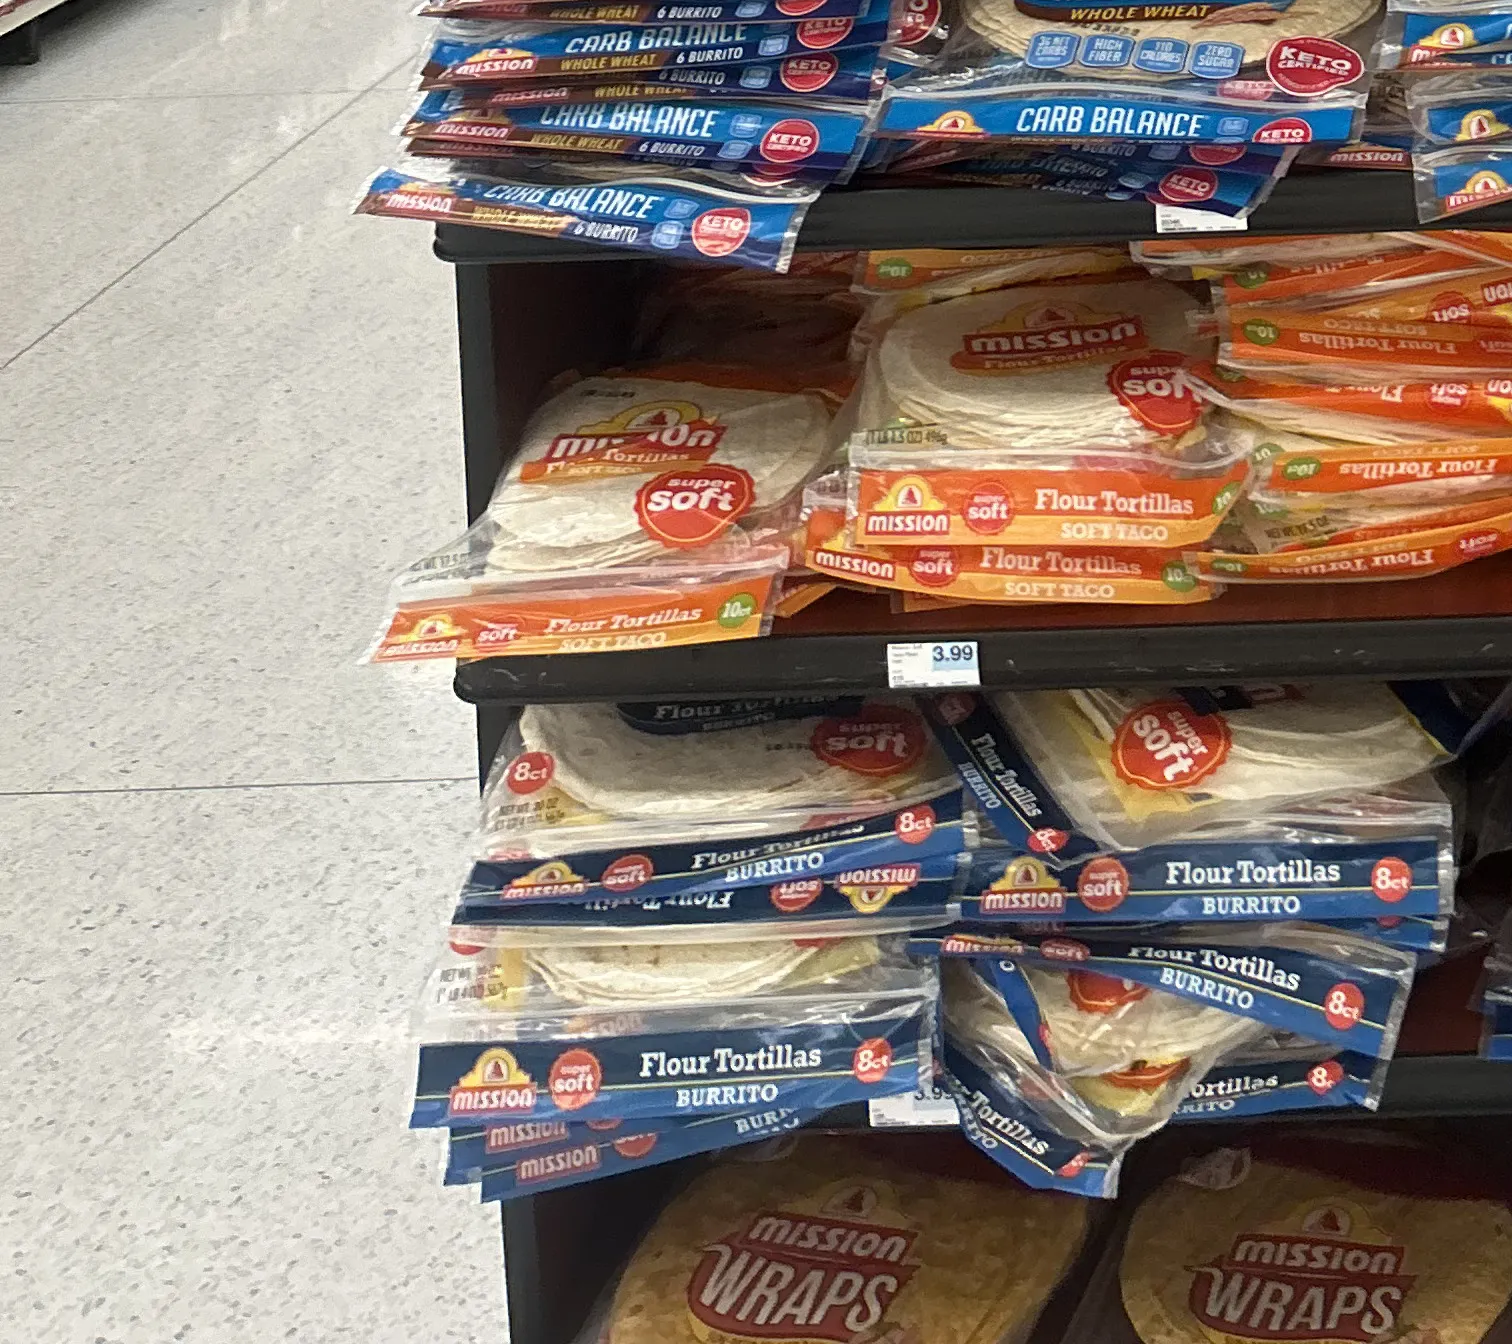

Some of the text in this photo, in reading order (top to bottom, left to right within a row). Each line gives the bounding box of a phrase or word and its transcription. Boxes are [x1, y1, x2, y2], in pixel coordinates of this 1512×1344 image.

[1069, 3, 1211, 21] WHOLE WHEAT
[1279, 45, 1352, 72] KETO
[1016, 107, 1204, 137] CARB BALANCE
[639, 140, 705, 156] 6 BURRITO
[768, 132, 813, 147] KETO
[667, 478, 736, 490] super
[646, 488, 735, 512] soft
[1035, 488, 1194, 515] Flour Tortillas
[1061, 523, 1168, 541] SOFT TACO
[979, 548, 1142, 575] Flour Tortillas
[1005, 582, 1115, 598] SOFT TACO
[933, 645, 974, 662] 3.99
[513, 761, 548, 782] 8ct
[899, 814, 934, 832] 8ct
[1166, 861, 1340, 884] Flour Tortillas
[1375, 867, 1409, 891] 8ct
[1082, 878, 1123, 897] soft
[1202, 895, 1301, 915] BURRITO
[1161, 968, 1256, 1009] BURRITO
[640, 1045, 822, 1078] Flour Tortillas
[858, 1050, 890, 1073] 8ct
[675, 1084, 779, 1108] BURRITO
[700, 1244, 901, 1335] WRAPS
[1196, 1267, 1405, 1336] WRAPS
